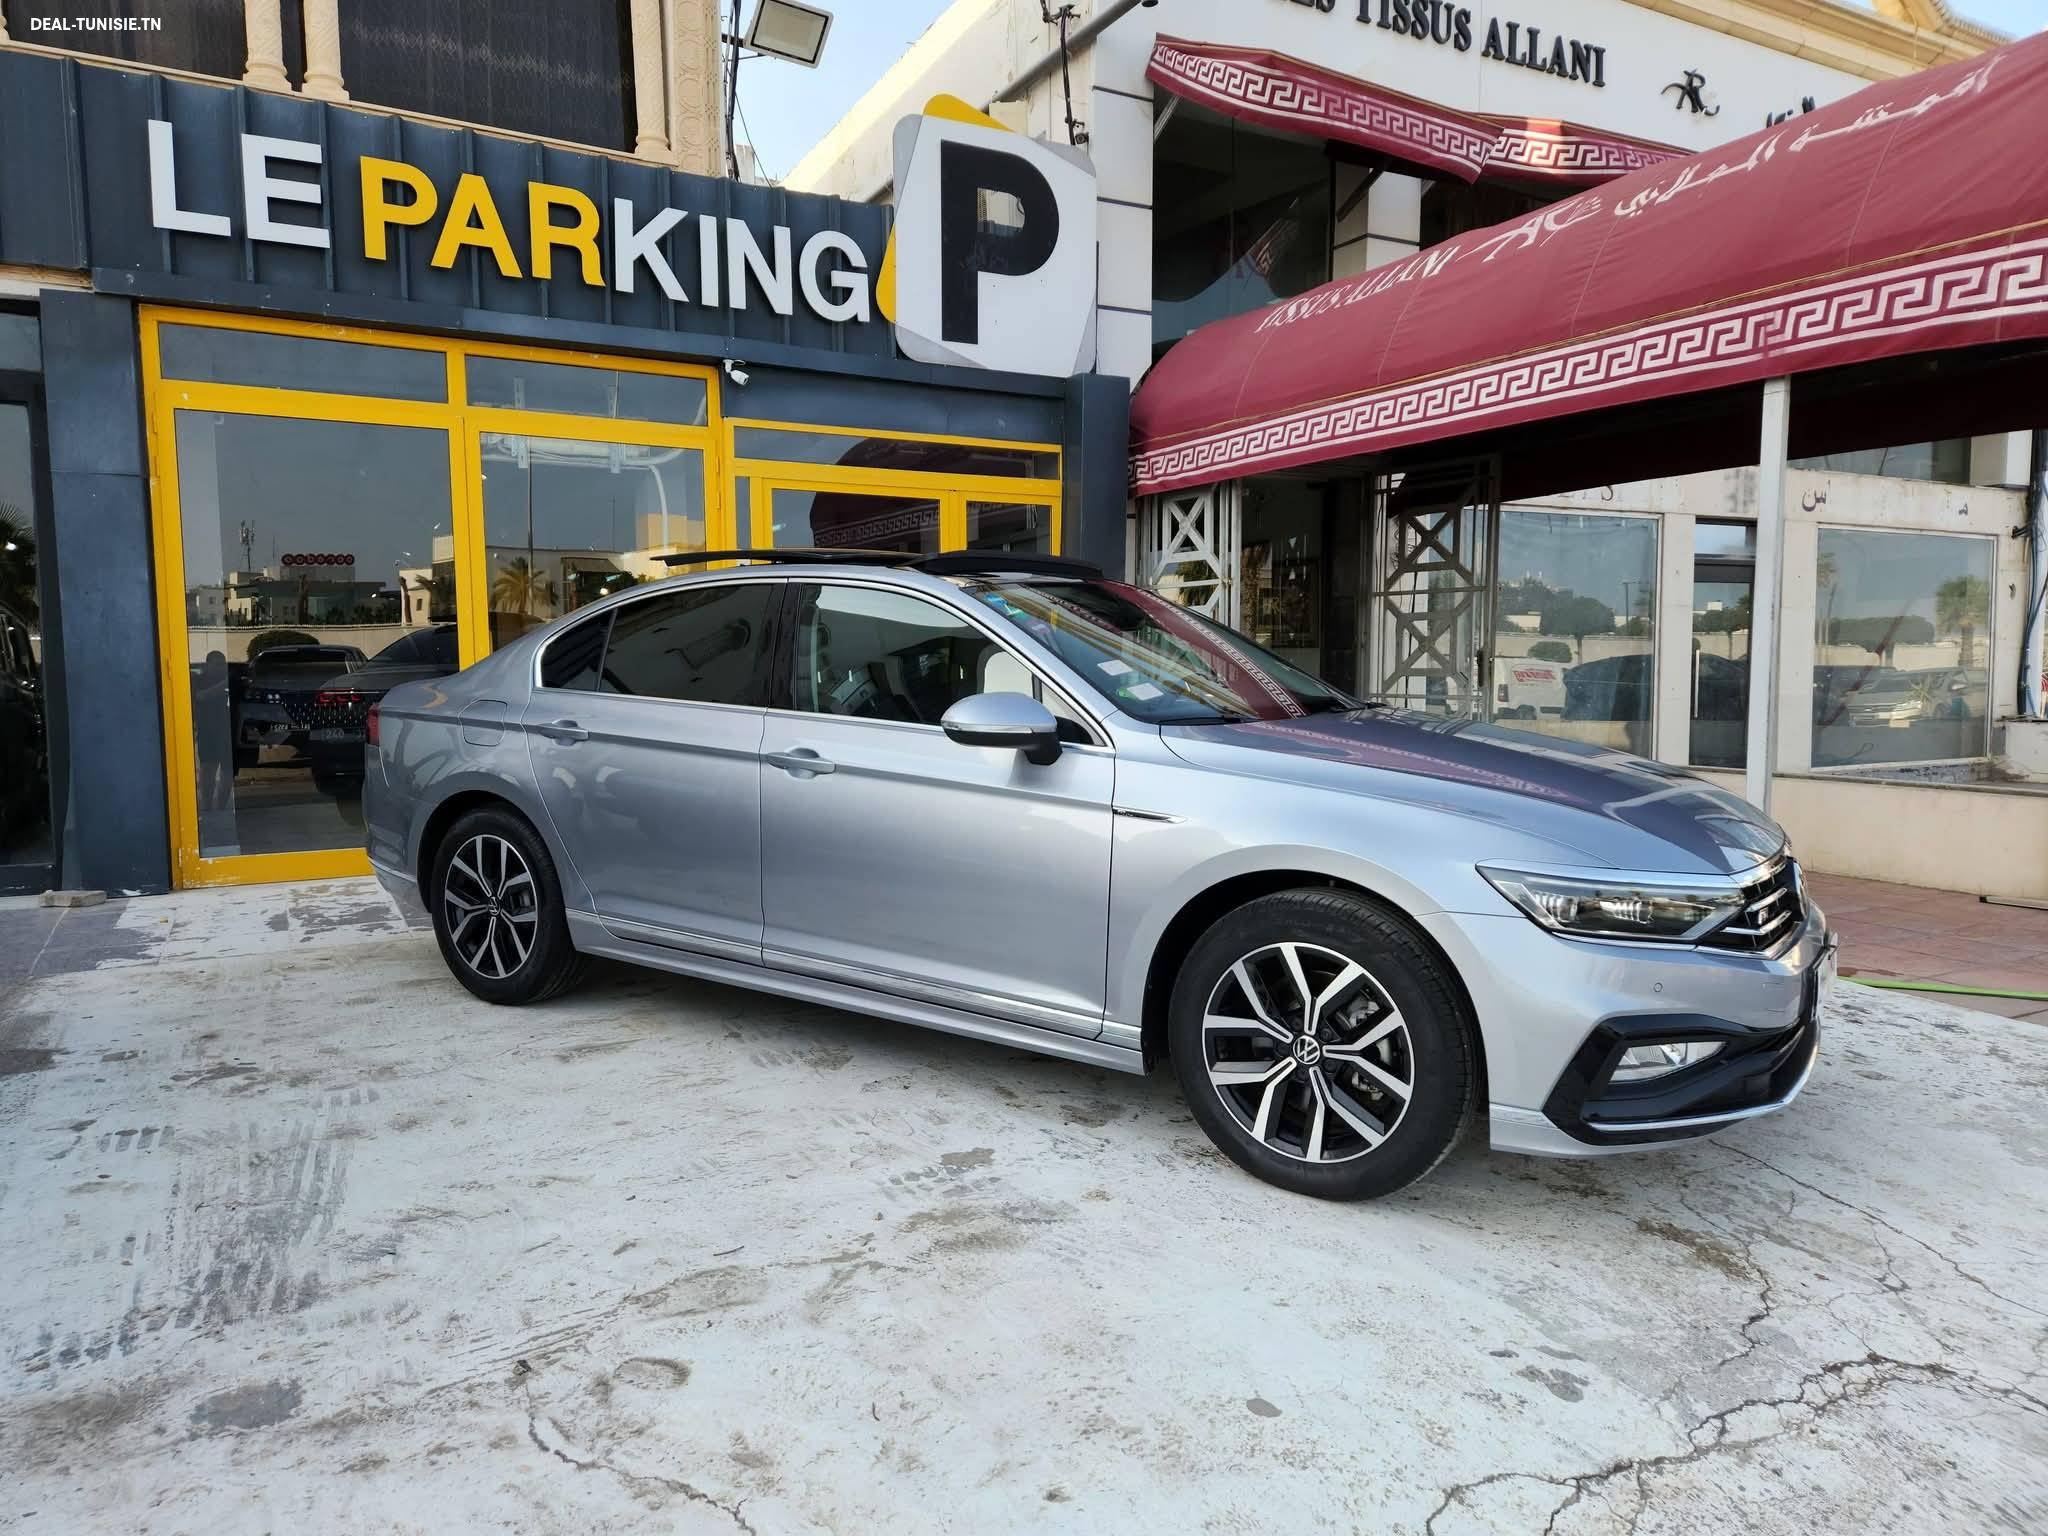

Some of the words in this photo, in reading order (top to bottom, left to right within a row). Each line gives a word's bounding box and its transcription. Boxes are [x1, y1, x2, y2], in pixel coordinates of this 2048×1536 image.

[1482, 16, 1606, 87] ALLANI
[148, 119, 331, 249] LE
[360, 155, 871, 323] PARKING
[940, 139, 1060, 345] P
[1254, 283, 1354, 333] TISSUS
[1344, 244, 1462, 305] ALLANI
